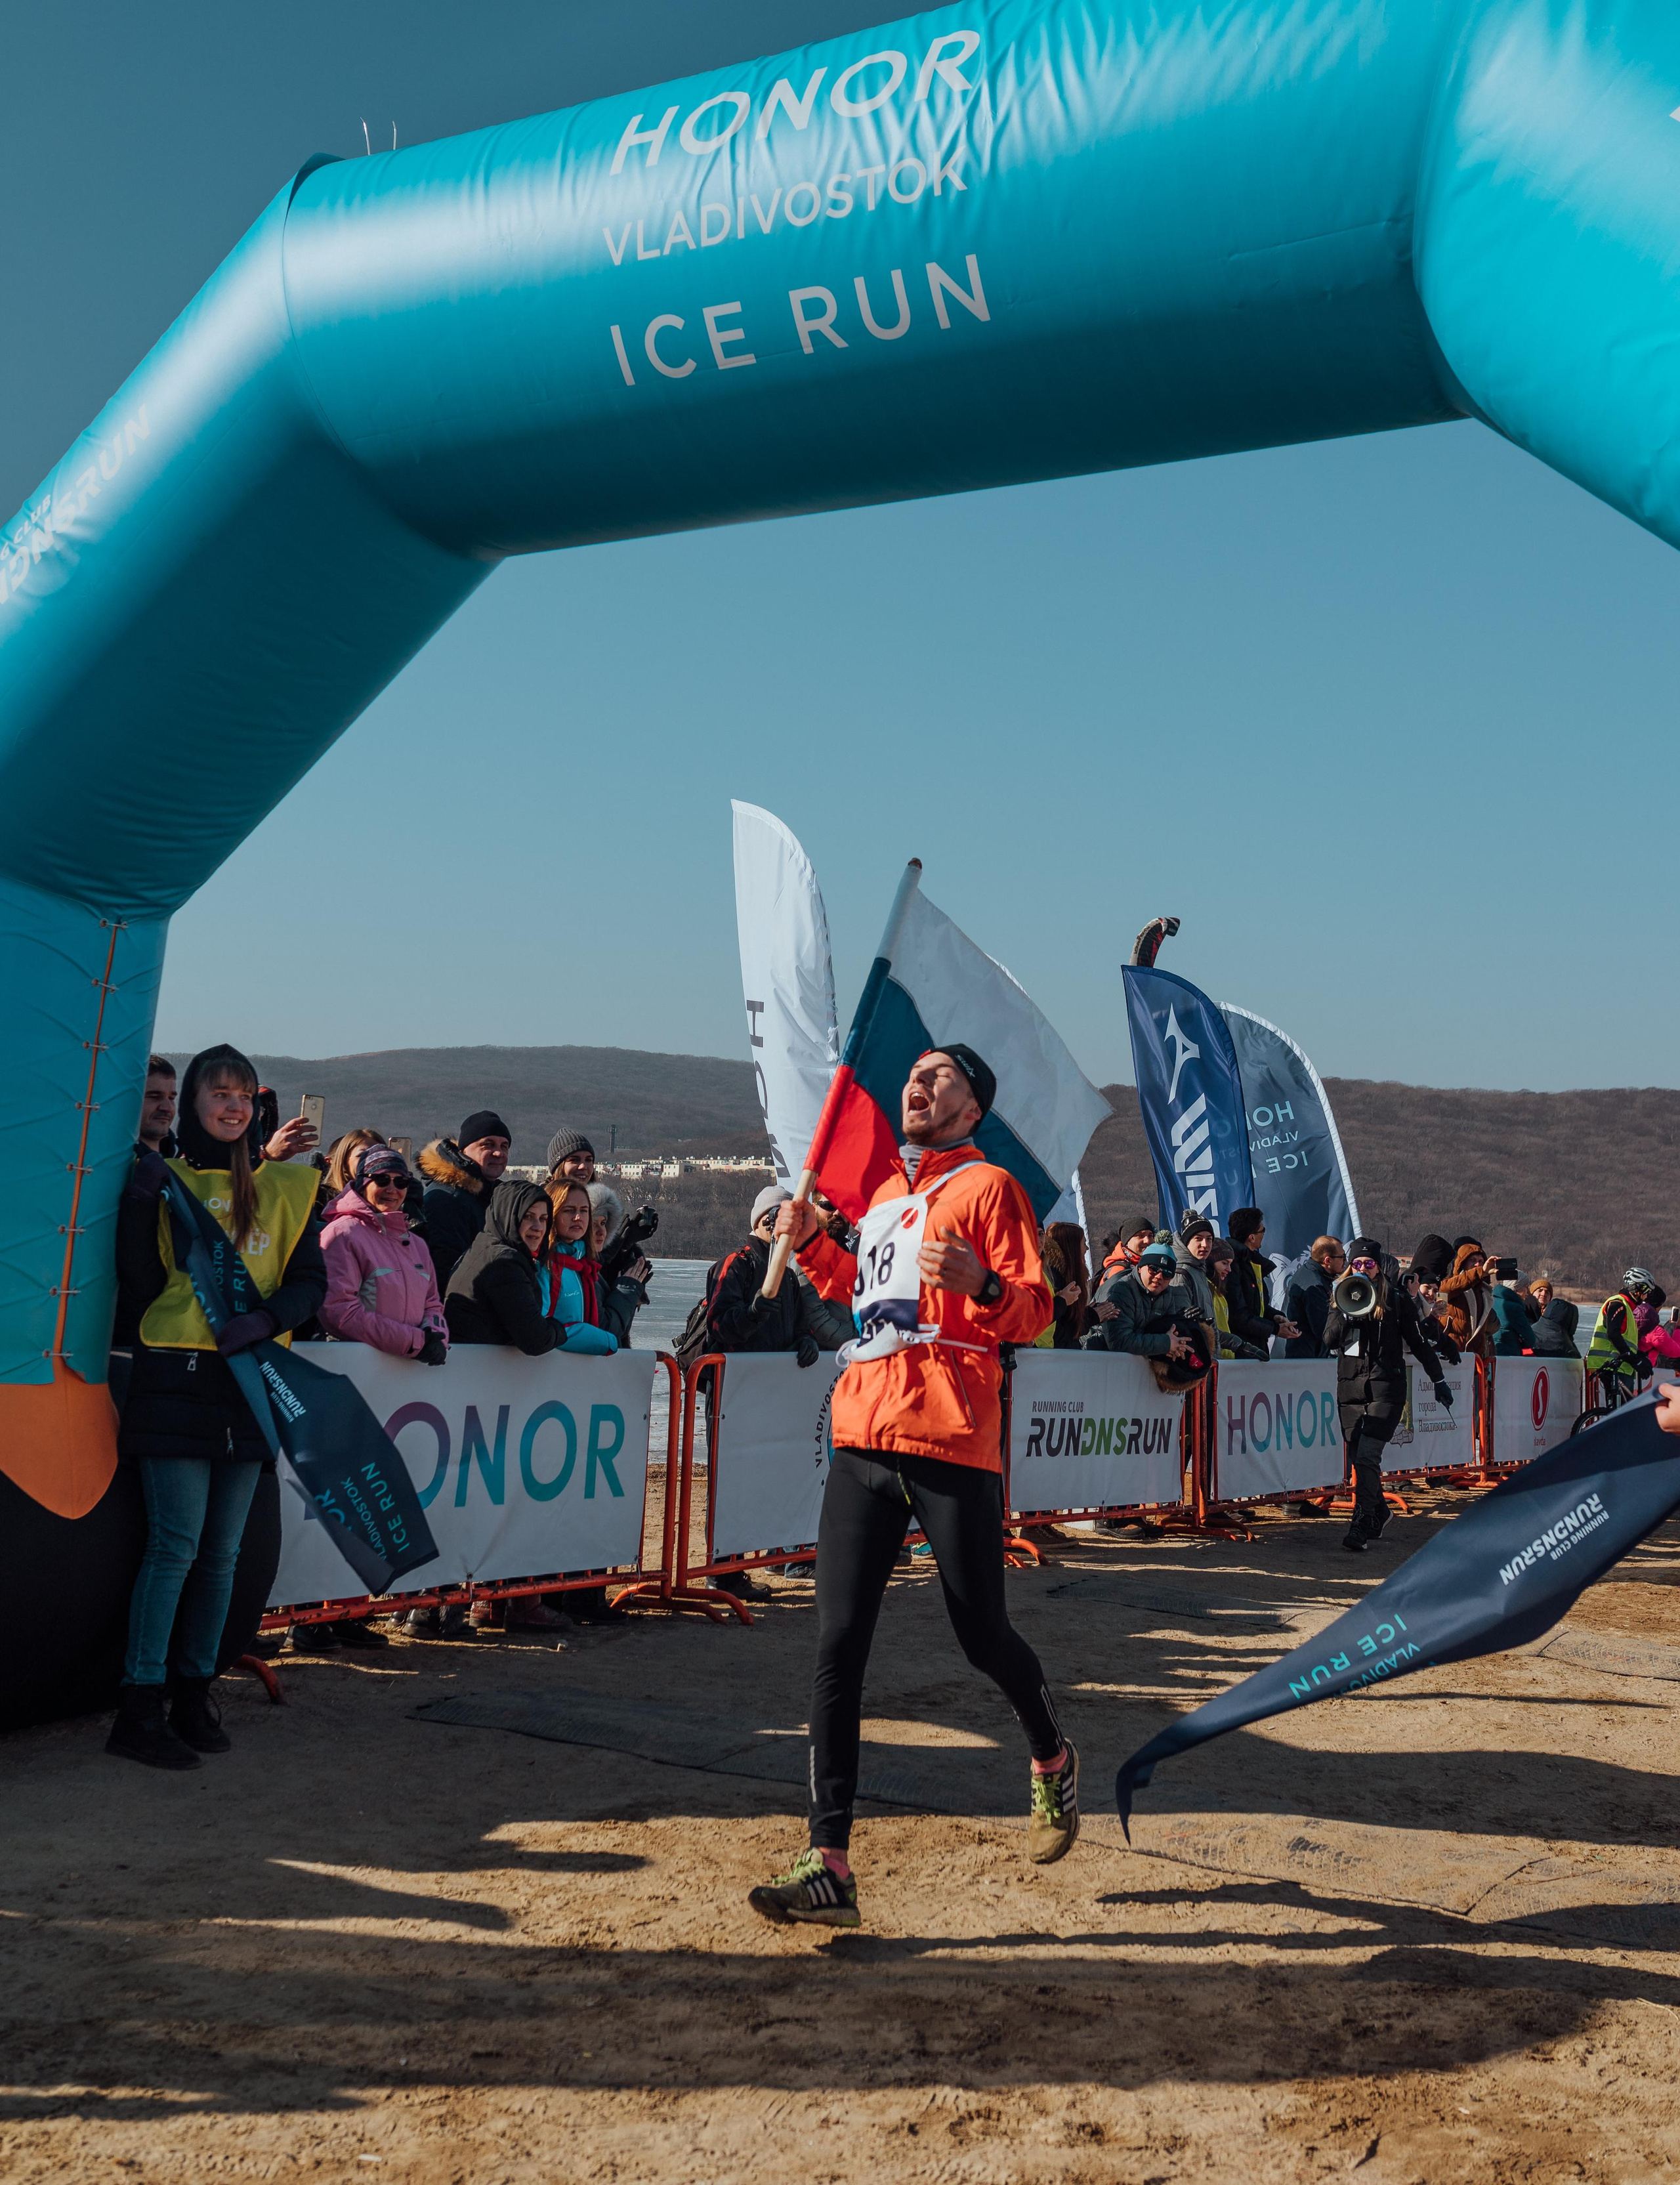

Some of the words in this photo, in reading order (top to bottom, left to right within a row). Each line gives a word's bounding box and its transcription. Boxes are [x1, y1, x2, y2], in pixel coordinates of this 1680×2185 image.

[610, 30, 980, 175] HONOR
[602, 145, 968, 266] VLADIVOSTOK
[610, 301, 757, 386] ICE
[788, 254, 991, 354] RUN
[1032, 1401, 1066, 1413] RUNNING
[1068, 1401, 1084, 1413] CLUB
[1227, 1390, 1337, 1455] HONOR
[1418, 1402, 1437, 1416] города
[304, 1400, 625, 1521] ONOR
[361, 1462, 395, 1512] RUN
[388, 1514, 410, 1553] ICE
[1549, 1540, 1572, 1561] CLUB
[1570, 1510, 1610, 1544] RUNNING
[1356, 1613, 1408, 1656] ICE
[1288, 1651, 1351, 1699] RUN
